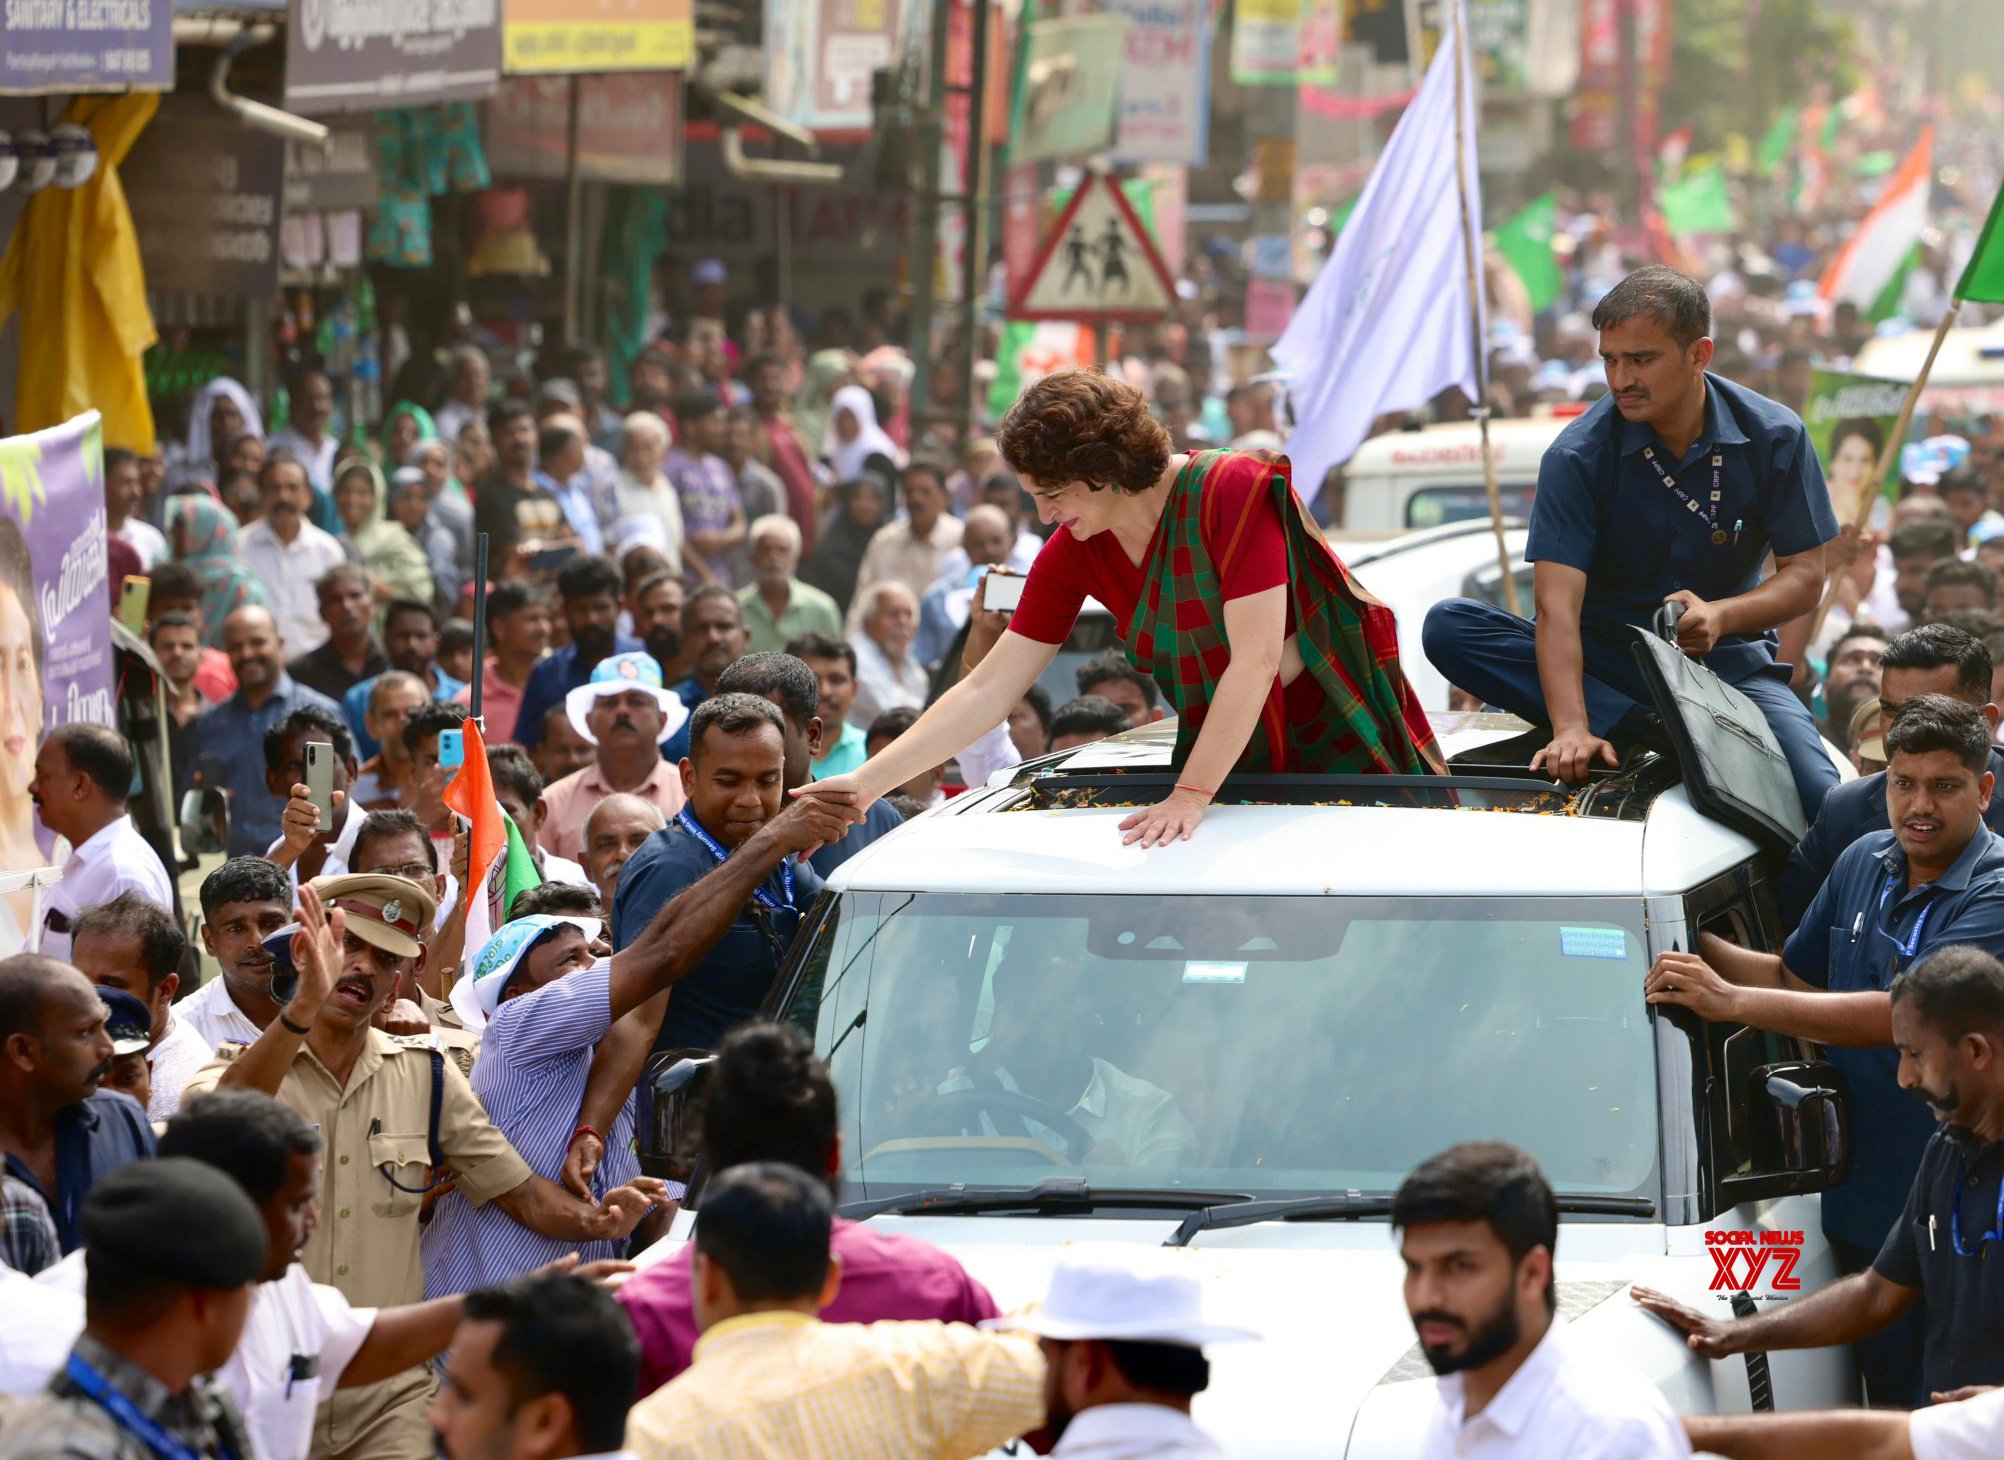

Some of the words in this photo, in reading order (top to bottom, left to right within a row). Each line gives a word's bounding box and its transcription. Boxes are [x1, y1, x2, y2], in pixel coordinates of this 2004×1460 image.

[5, 0, 63, 31] SANITARY
[65, 0, 75, 31] &
[77, 0, 152, 31] ELECTRICALS
[1651, 460, 1665, 476] CRPF
[1674, 487, 1689, 501] CRPF
[695, 831, 717, 851] Security
[1909, 919, 1923, 950] Security
